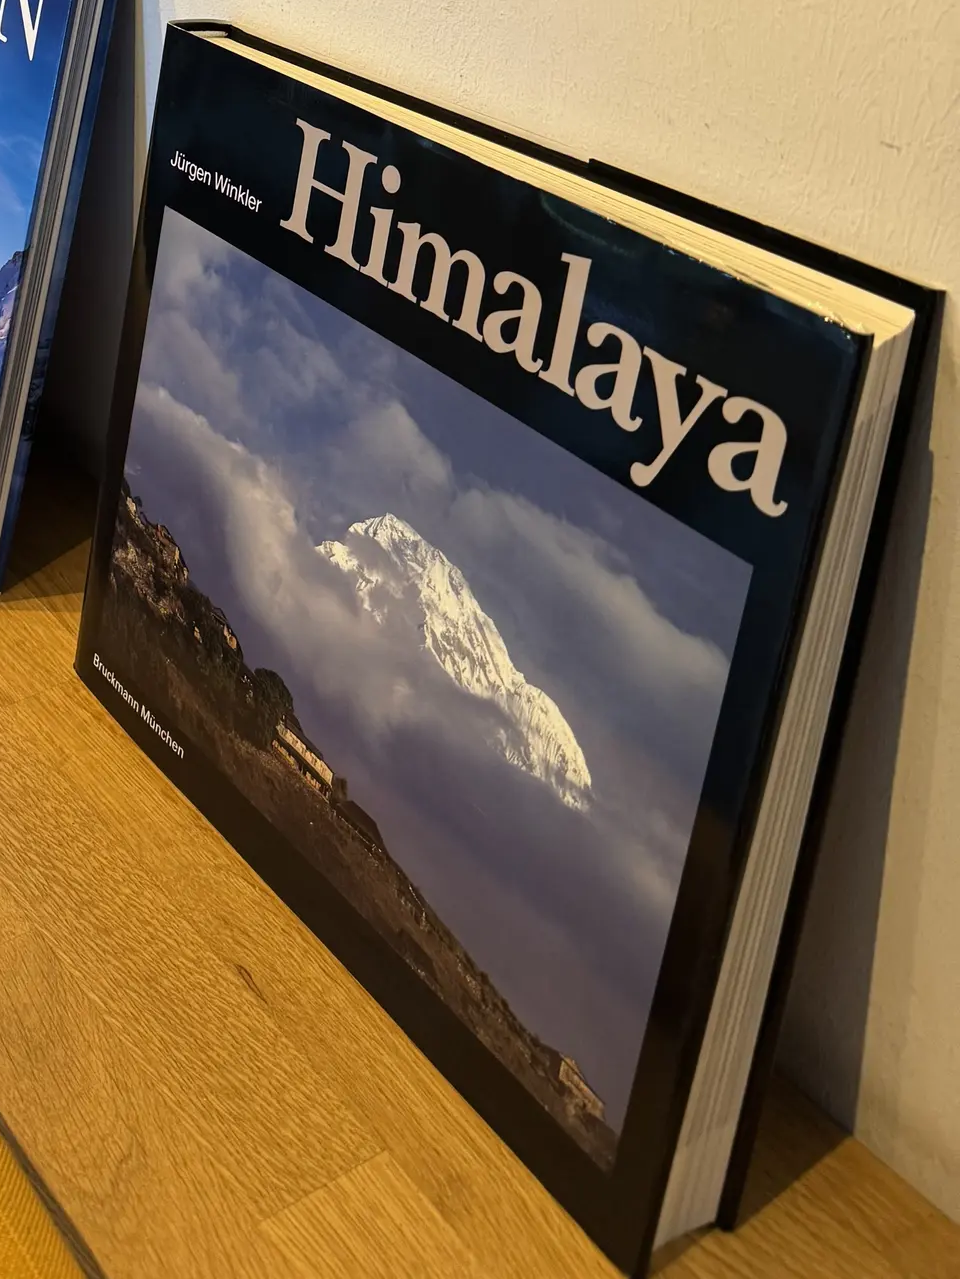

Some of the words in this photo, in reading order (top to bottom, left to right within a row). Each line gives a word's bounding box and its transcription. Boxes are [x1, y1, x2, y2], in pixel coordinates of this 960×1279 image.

[170, 150, 212, 186] Jürgen
[215, 171, 263, 213] Winkler
[279, 117, 789, 518] Himalaya
[92, 652, 140, 713] Bruckmann
[140, 704, 185, 759] München
